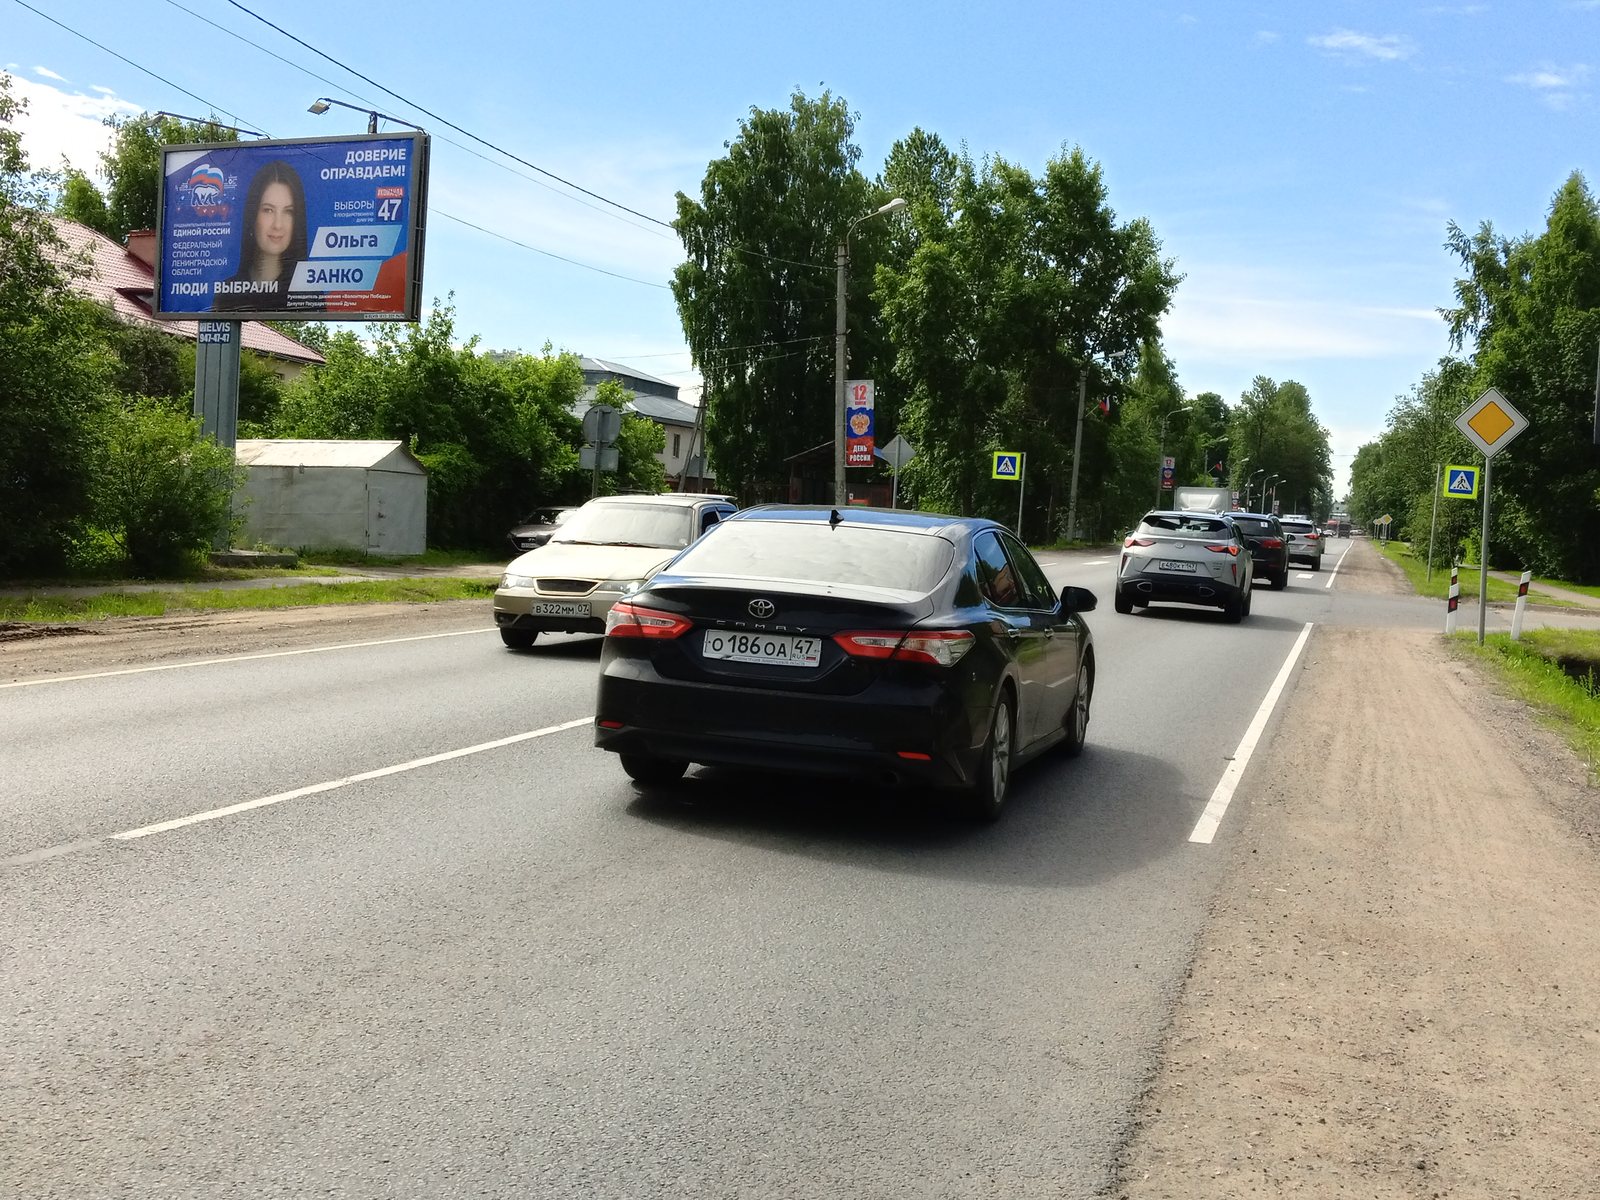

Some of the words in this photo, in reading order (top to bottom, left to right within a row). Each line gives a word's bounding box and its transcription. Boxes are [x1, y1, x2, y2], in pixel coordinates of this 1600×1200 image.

[345, 148, 406, 164] ДОВЕРИЕ
[320, 165, 406, 180] ОПРАВДАЕМ!
[334, 200, 375, 210] ВЫБОРЫ
[377, 199, 402, 221] 47
[173, 227, 201, 237] ЕДИНОЙ
[202, 227, 231, 236] РОССИИ
[172, 240, 223, 250] ФЕДЕРАЛЬНЫЙ
[325, 232, 378, 248] Ольга
[172, 250, 199, 258] СПИСОК
[200, 250, 211, 258] ПО
[172, 258, 228, 267] ЛЕНИНГРАДСКОЙ
[171, 268, 202, 276] ОБЛАСТИ
[306, 268, 364, 284] ЗАНКО
[170, 282, 208, 297] ЛЮДИ
[213, 280, 279, 295] ВЫБРАЛИ
[853, 385, 867, 401] 12
[852, 445, 867, 453] ДЕНЬ
[849, 454, 871, 462] РОССИИ
[794, 639, 814, 655] 47
